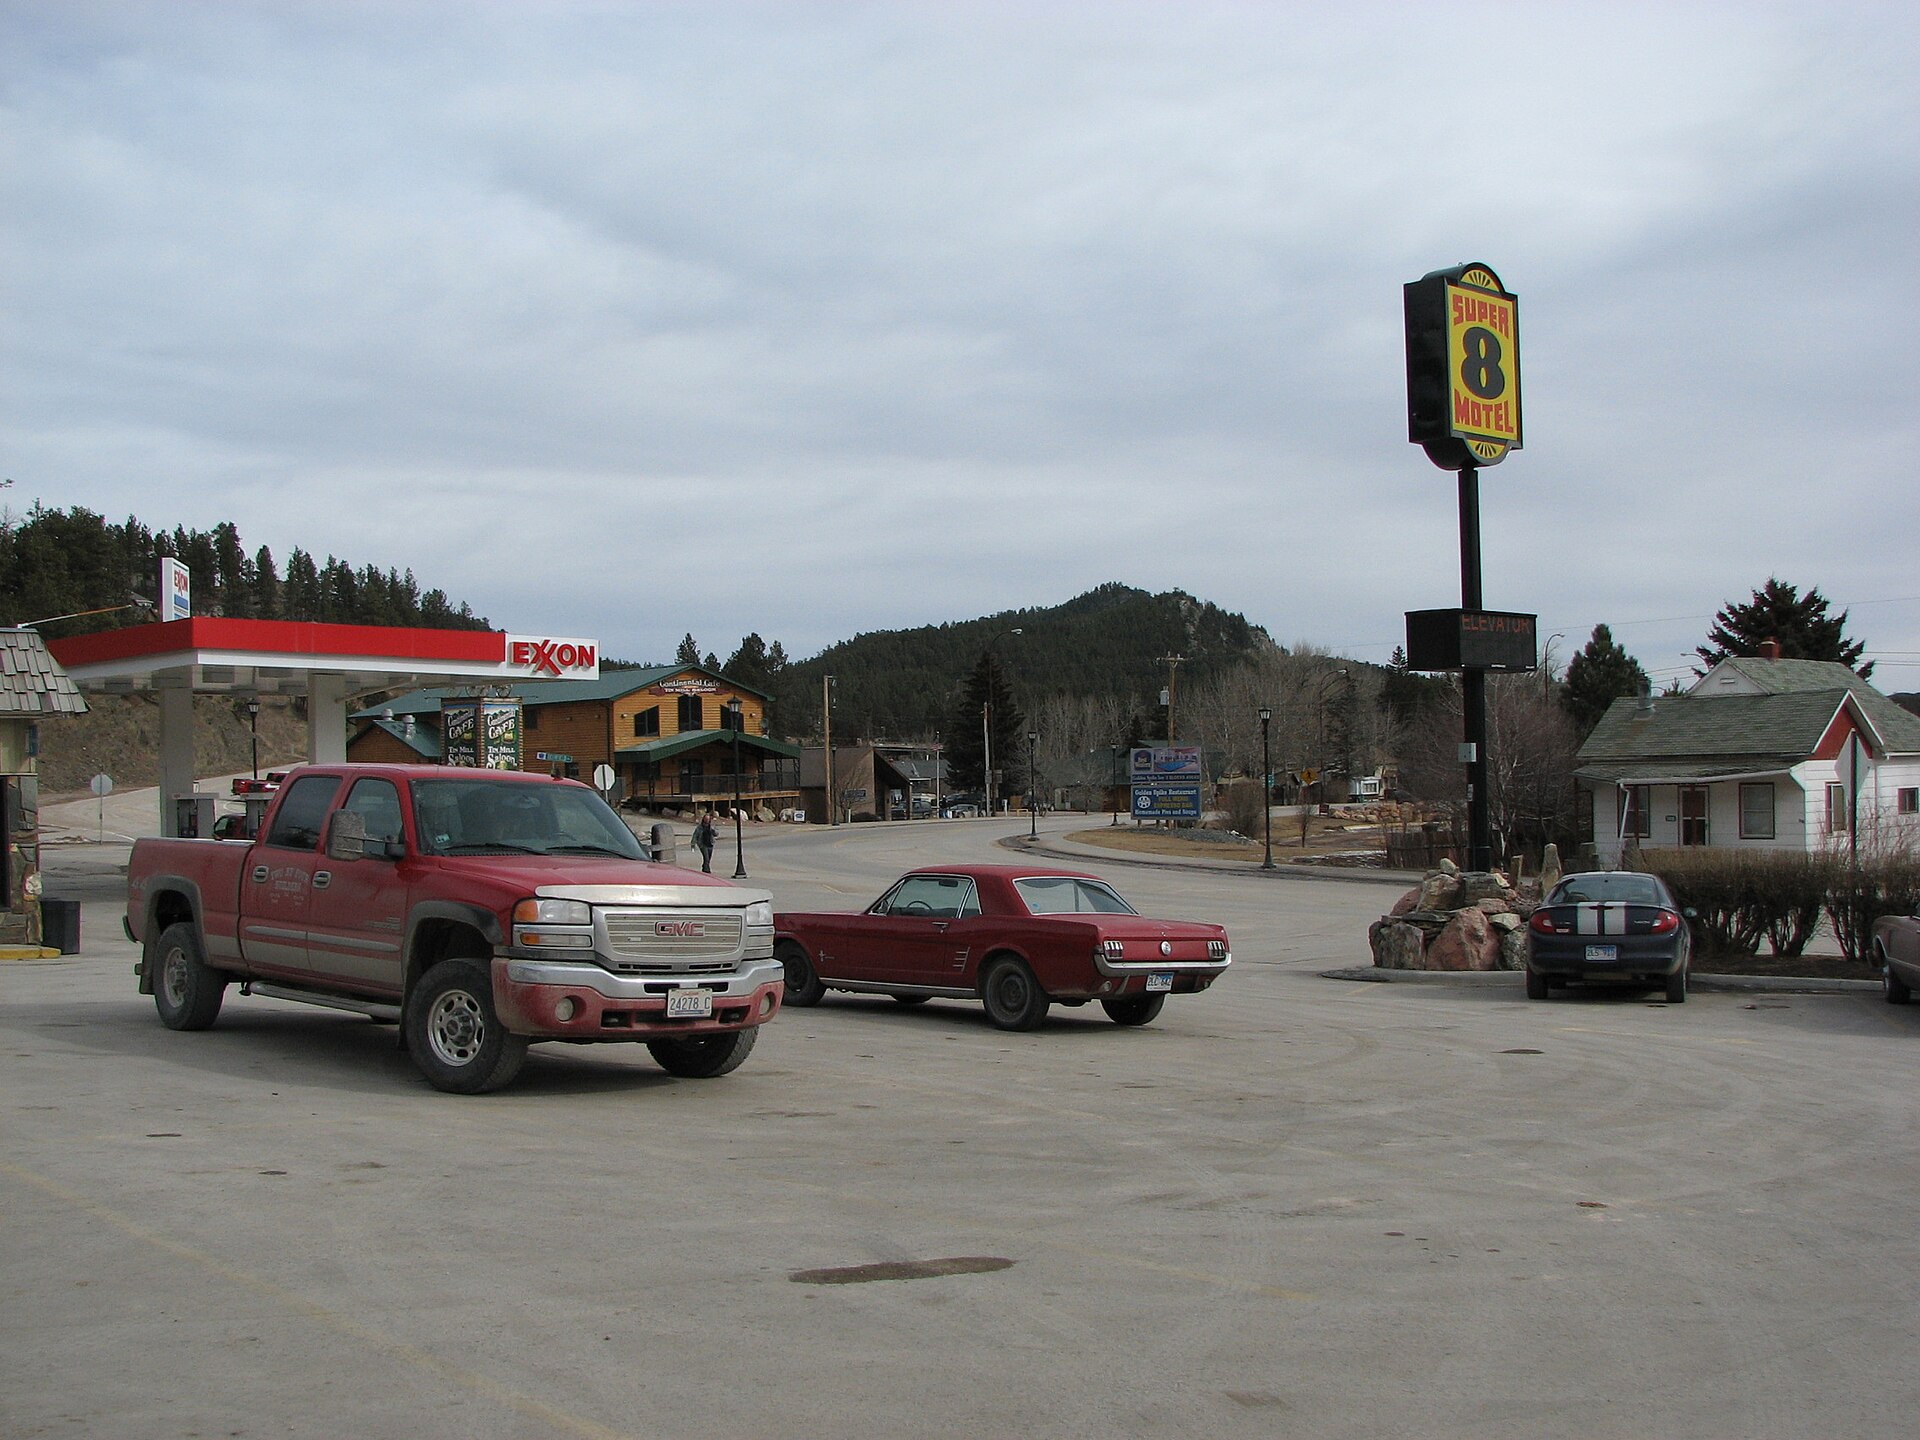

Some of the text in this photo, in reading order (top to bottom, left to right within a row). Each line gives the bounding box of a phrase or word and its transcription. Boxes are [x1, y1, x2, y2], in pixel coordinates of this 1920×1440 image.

[1453, 294, 1509, 339] SUPER
[1461, 327, 1505, 399] 8
[1454, 388, 1514, 433] MOTEL
[174, 570, 188, 596] EXXON
[1462, 614, 1530, 634] ELEVATOR
[511, 639, 595, 675] EXXON
[660, 679, 702, 688] Continental
[488, 718, 515, 739] CAFE
[486, 754, 517, 769] Saloon
[655, 921, 705, 936] GMC
[670, 996, 711, 1010] 24278 C
